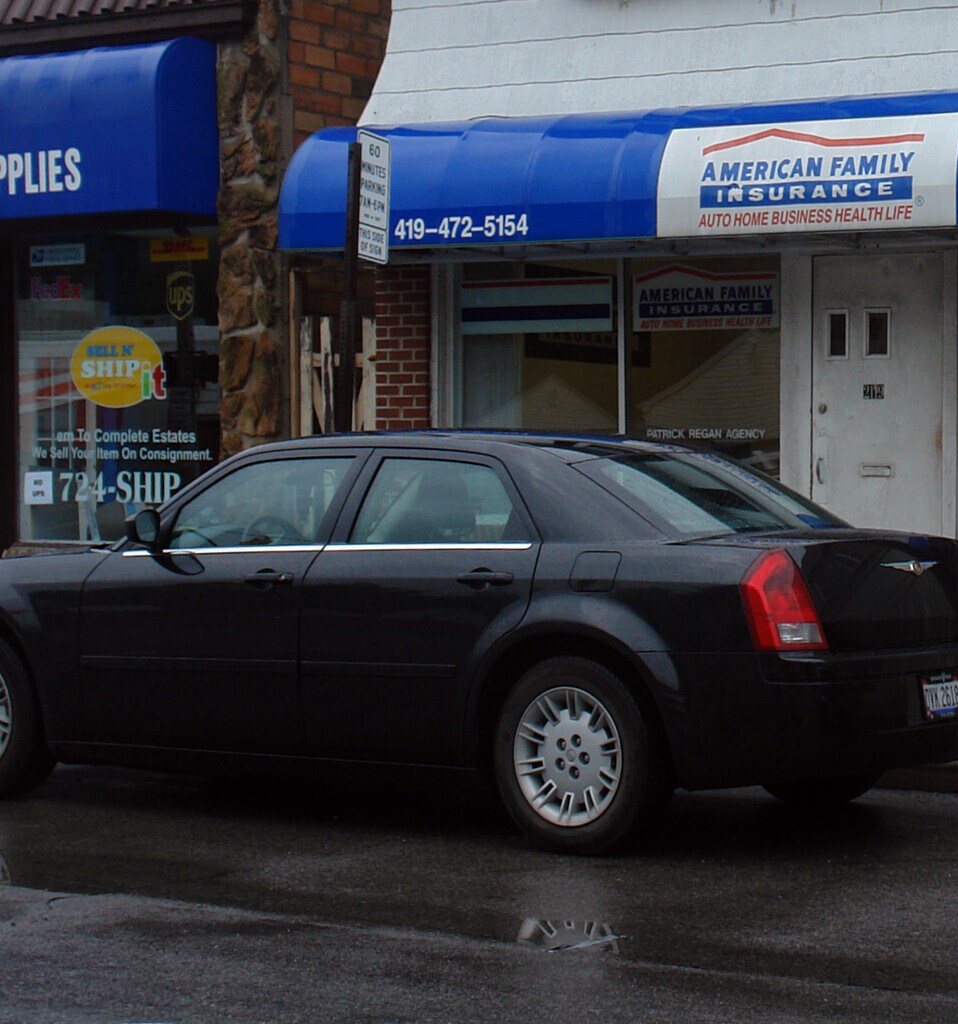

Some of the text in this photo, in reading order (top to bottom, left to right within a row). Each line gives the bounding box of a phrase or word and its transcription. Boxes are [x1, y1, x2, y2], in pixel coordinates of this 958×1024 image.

[369, 144, 381, 158] 60
[361, 162, 387, 179] MINUTES
[701, 151, 915, 183] AMERICAN FAMILY
[360, 178, 386, 196] PARKING
[716, 181, 893, 203] INSURANCE
[698, 205, 913, 228] AUTO HOME BUSINESS HEALTH LIFE
[394, 213, 529, 240] 419-472-5154
[372, 230, 384, 244] SIDE
[369, 245, 382, 256] SIGN
[31, 275, 82, 301] FedEx
[640, 285, 773, 302] AMERICAN FAMILY
[169, 285, 193, 311] ups
[649, 302, 763, 315] INSURANCE
[640, 316, 772, 328] AUTO HOME BUSINESS HEALTH LIFE
[87, 344, 118, 357] SELL
[81, 359, 167, 399] SHIP it
[77, 428, 91, 442] To
[94, 429, 149, 445] Complete
[152, 428, 196, 444] Estates
[646, 428, 766, 439] PATRICK REGAN AGENCY
[32, 446, 213, 463] We Sell Your Item On Consignment.
[59, 470, 181, 504] 724-SHIP
